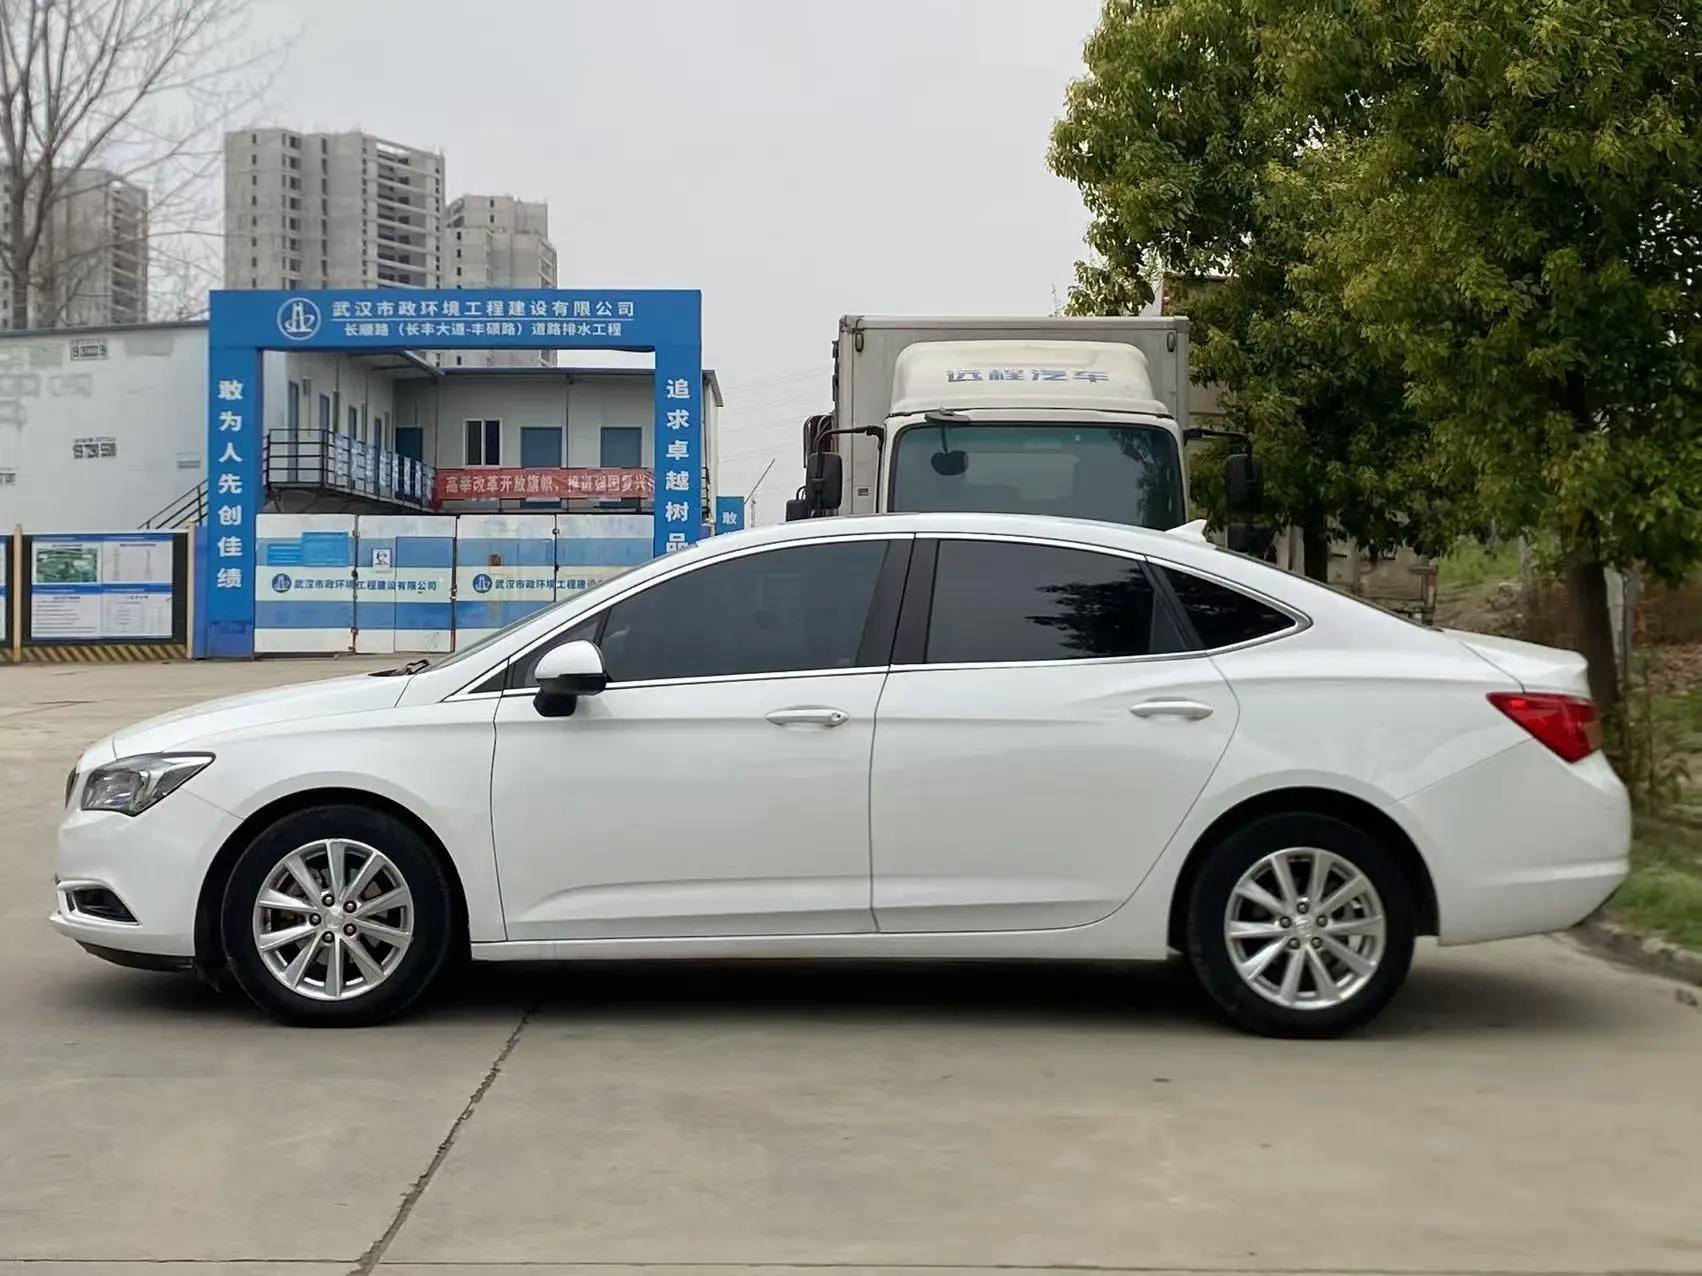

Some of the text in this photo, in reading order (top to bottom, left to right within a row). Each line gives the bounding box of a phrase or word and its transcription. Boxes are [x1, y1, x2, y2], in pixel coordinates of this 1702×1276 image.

[332, 301, 634, 317] 武汉市政环境工程建设有限公司
[217, 379, 244, 588] 敢为人先创佳绩
[294, 579, 437, 591] 武汉市政环境工程建设有限公司
